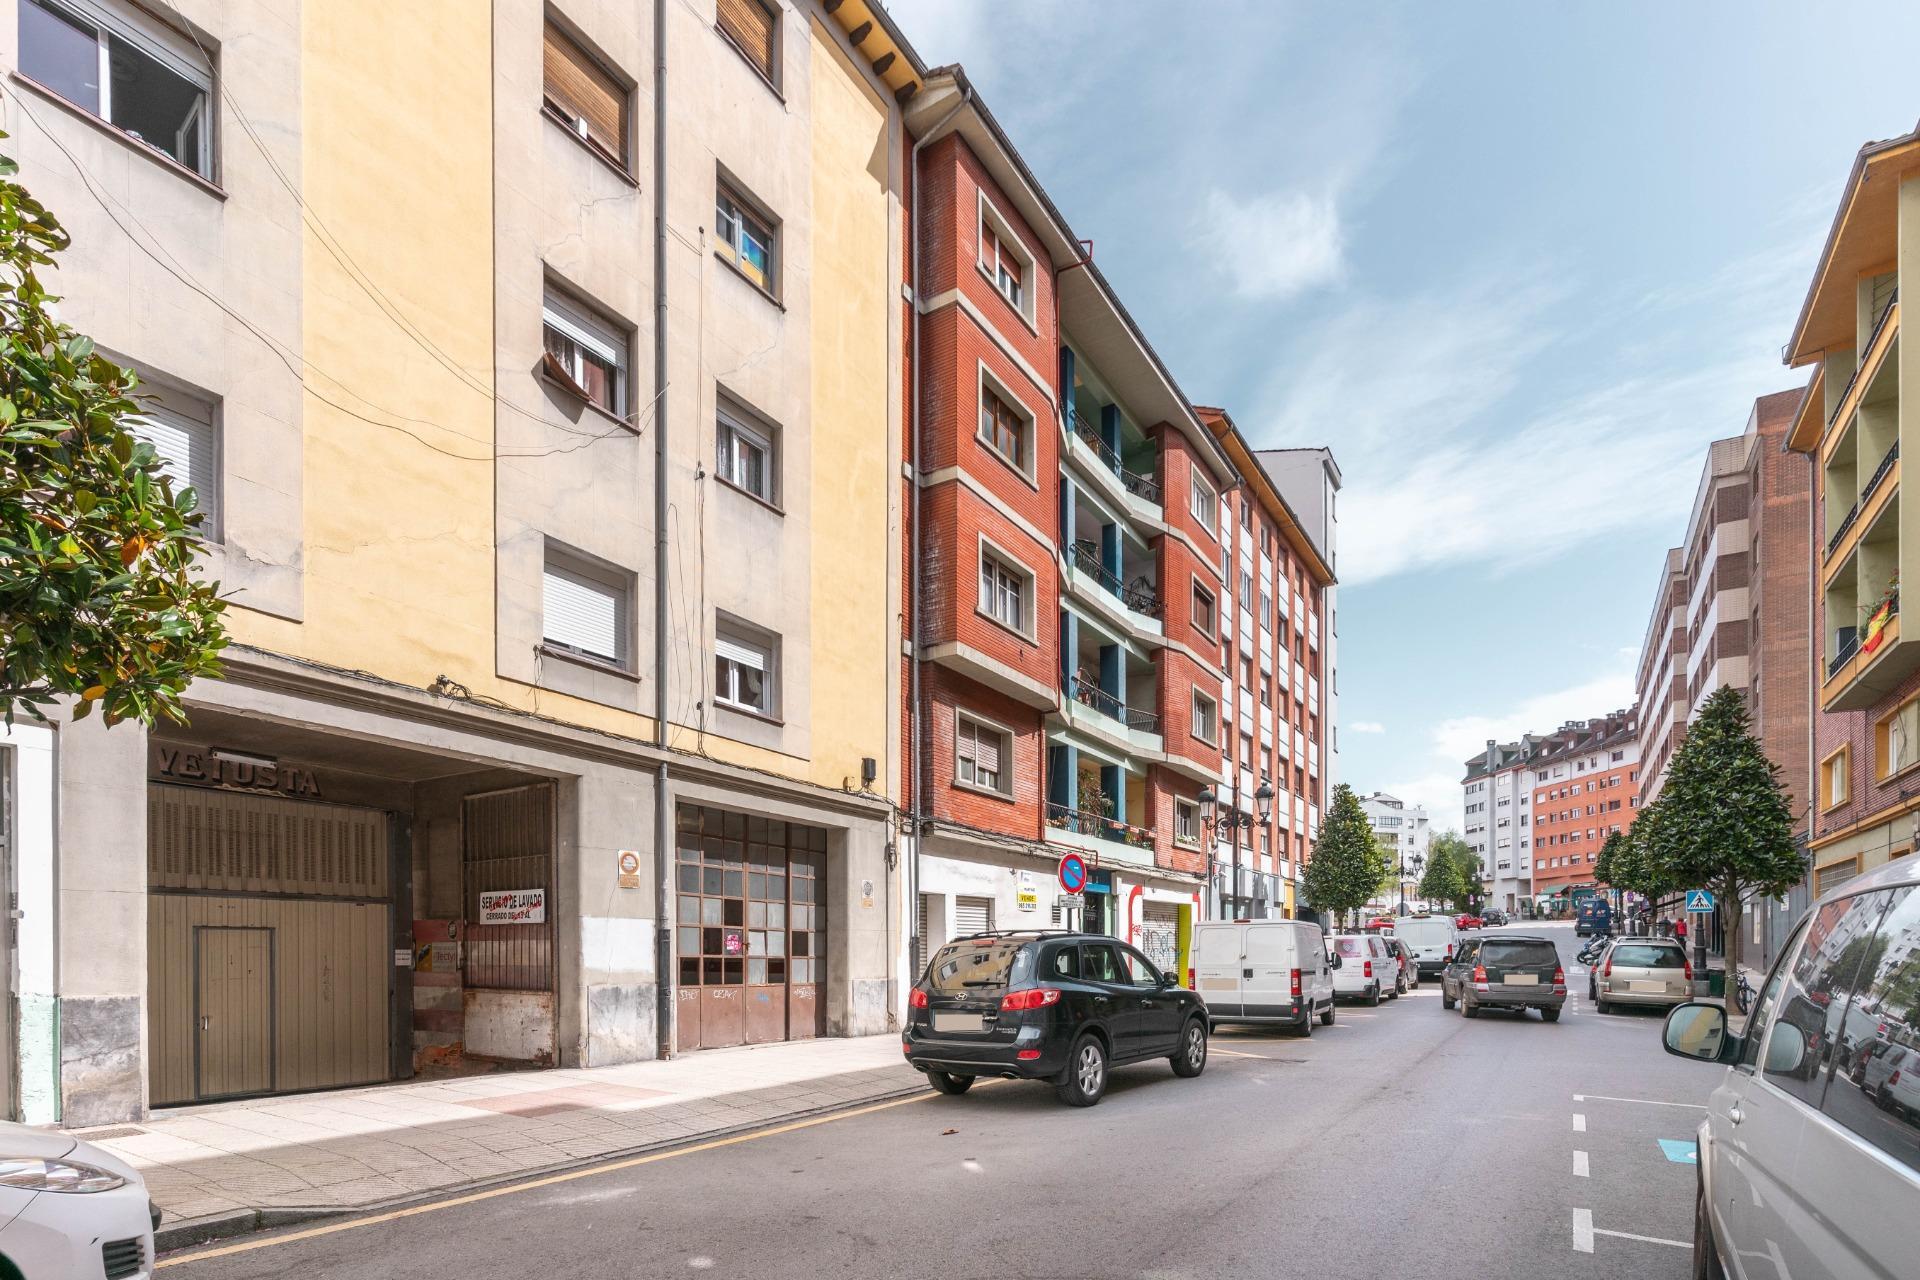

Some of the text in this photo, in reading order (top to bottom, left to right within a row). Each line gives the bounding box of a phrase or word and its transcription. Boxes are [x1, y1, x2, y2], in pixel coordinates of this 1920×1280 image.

[157, 748, 322, 797] VETUSTA
[481, 893, 542, 909] SERVICIO DE LAVADO
[486, 911, 508, 920] CERRADO
